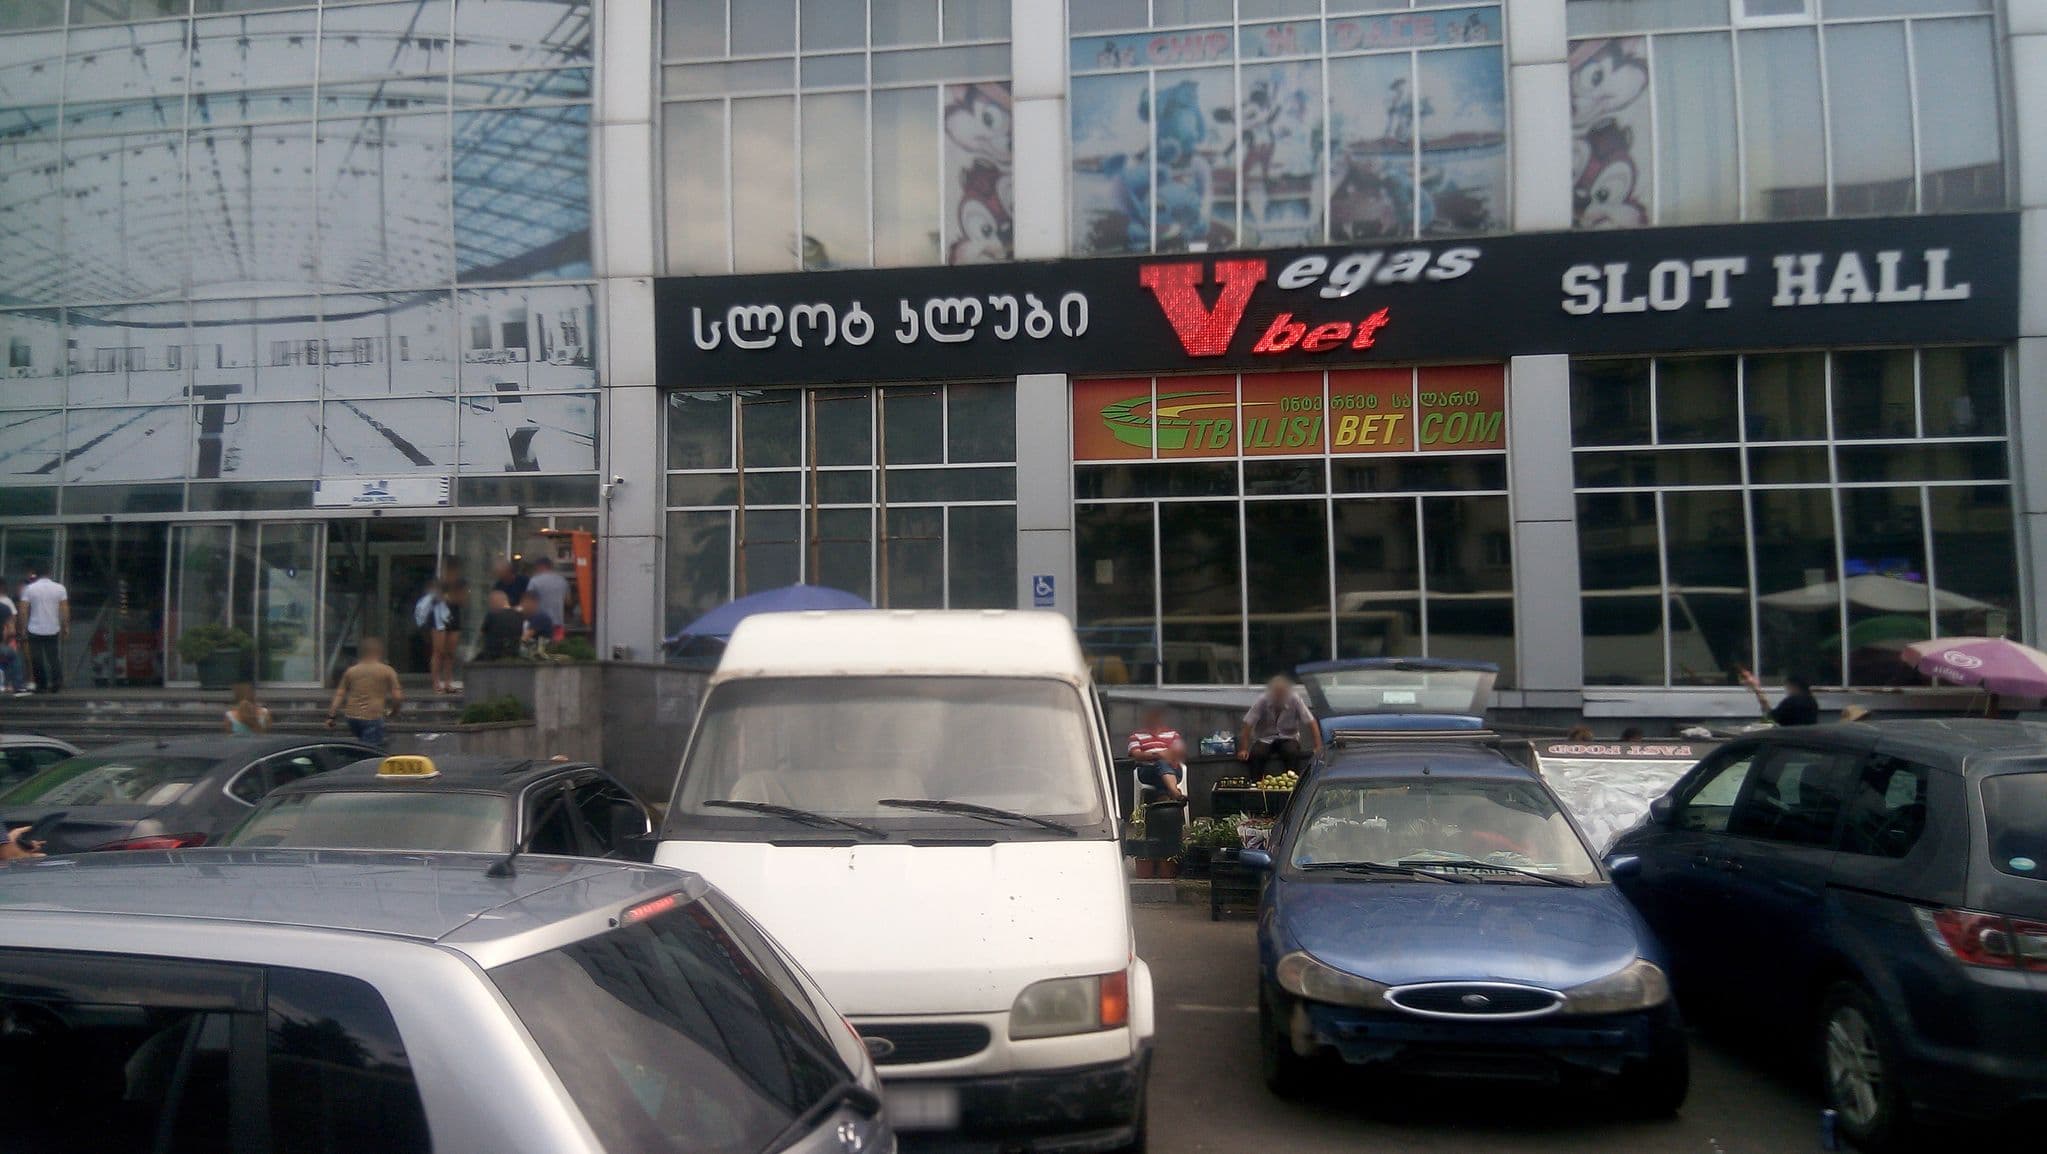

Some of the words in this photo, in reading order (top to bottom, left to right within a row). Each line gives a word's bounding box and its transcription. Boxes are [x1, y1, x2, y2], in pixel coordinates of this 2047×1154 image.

[1147, 32, 1228, 64] CHIP
[1334, 15, 1438, 50] DALE
[1560, 256, 1748, 316] SLOT
[1771, 248, 1971, 307] HALL
[692, 301, 875, 351] სლოტ
[895, 292, 1090, 345] კლუბი
[1251, 306, 1391, 354] bet
[385, 759, 424, 774] TAXI
[1548, 744, 1621, 755] FOOD
[1626, 745, 1693, 756] FAST
